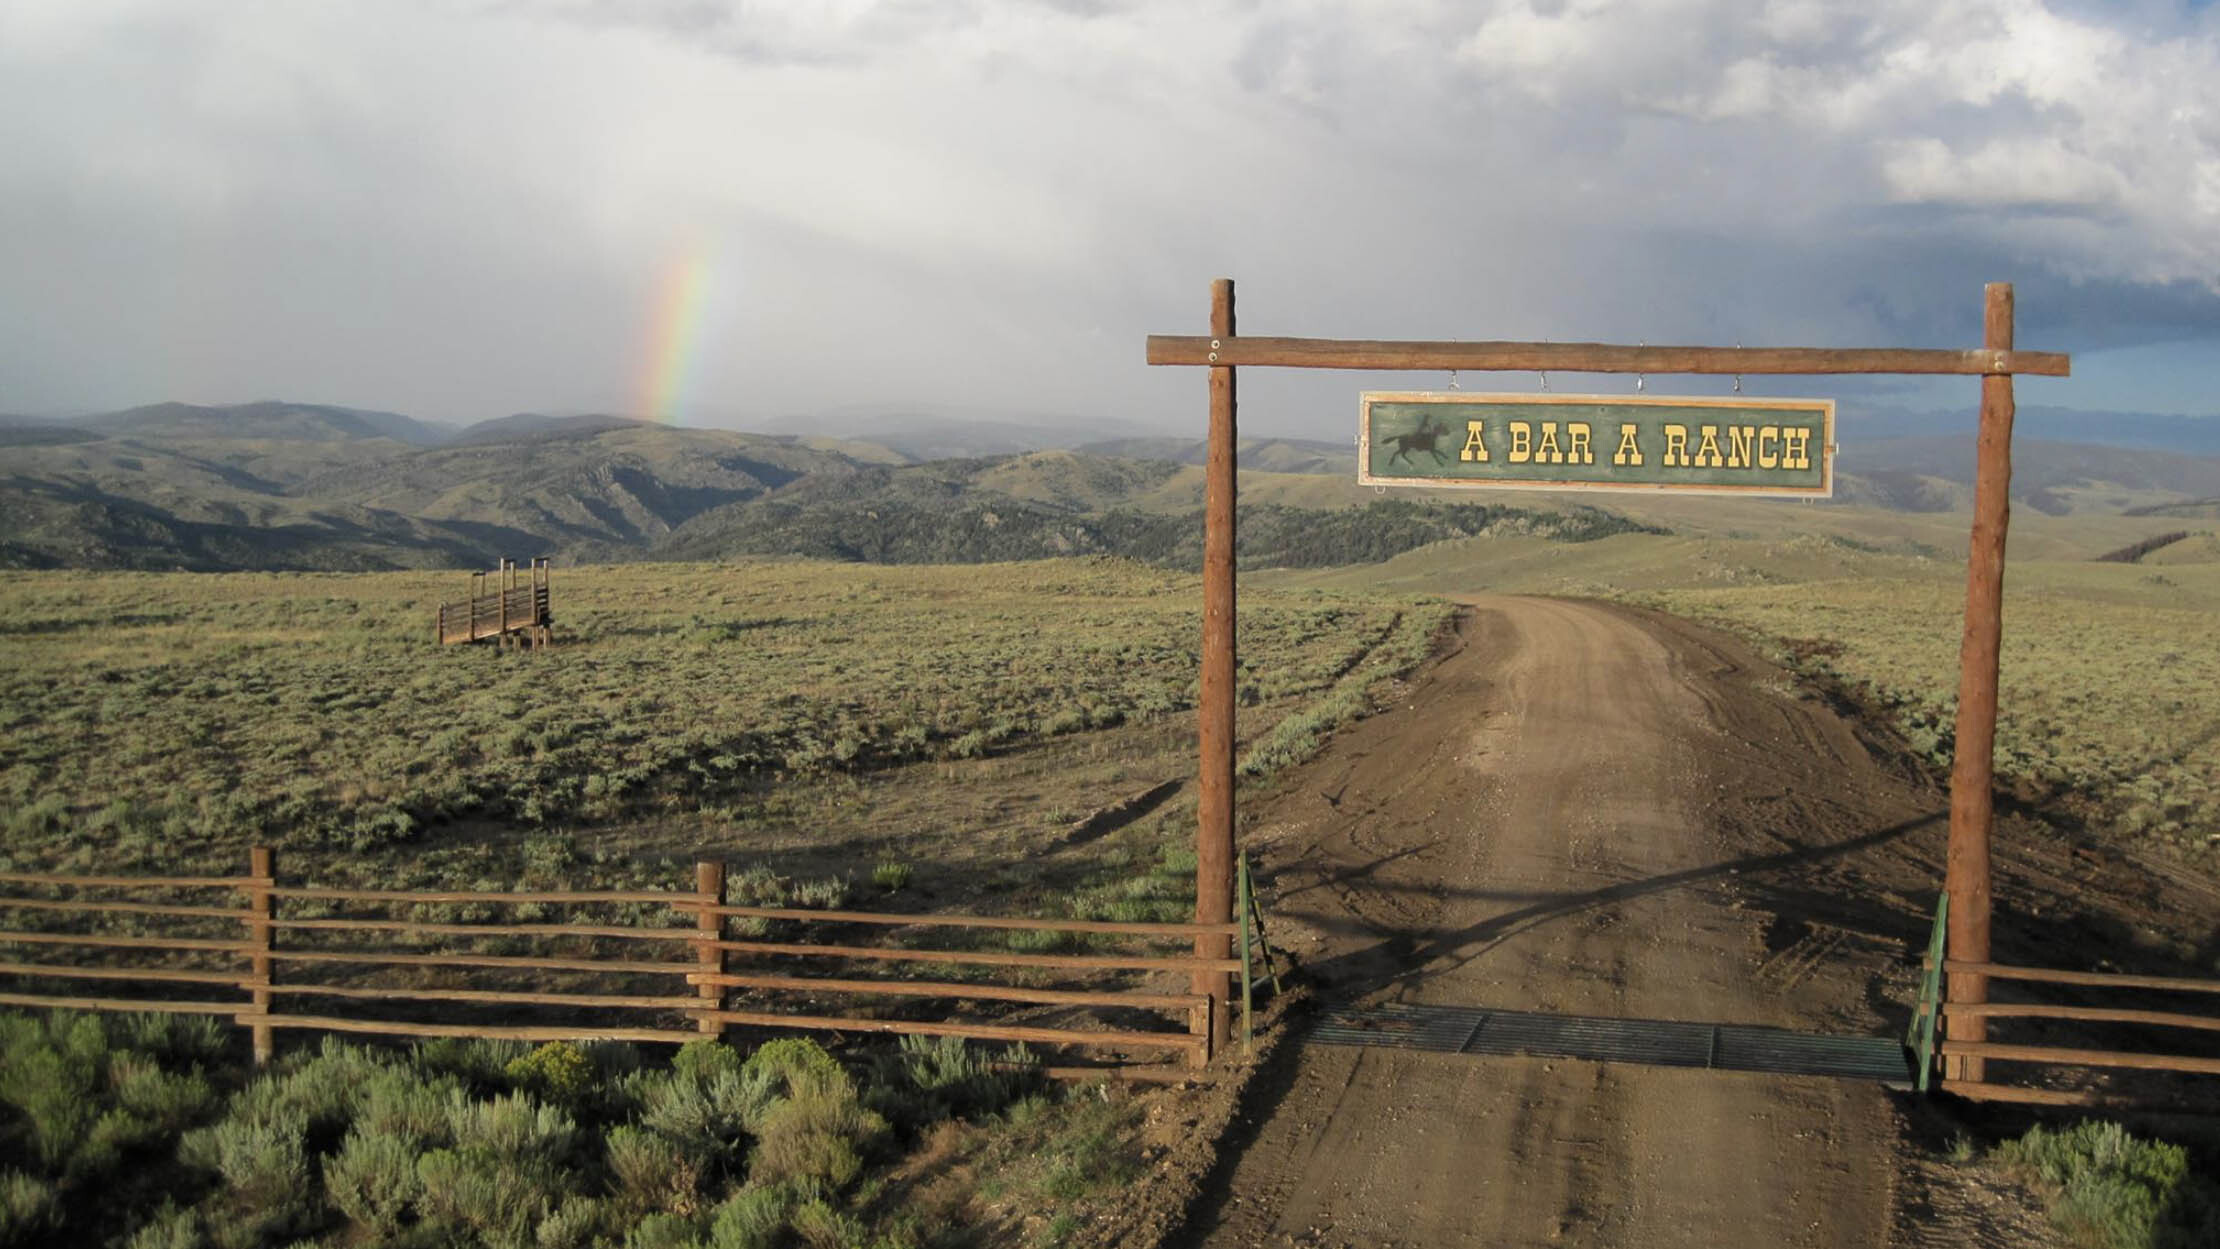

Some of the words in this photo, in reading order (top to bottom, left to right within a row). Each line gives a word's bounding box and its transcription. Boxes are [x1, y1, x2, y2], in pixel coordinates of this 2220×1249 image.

[1460, 420, 1489, 462] A
[1508, 421, 1594, 464] BAR
[1613, 423, 1643, 466] A
[1663, 423, 1810, 469] RANCH
